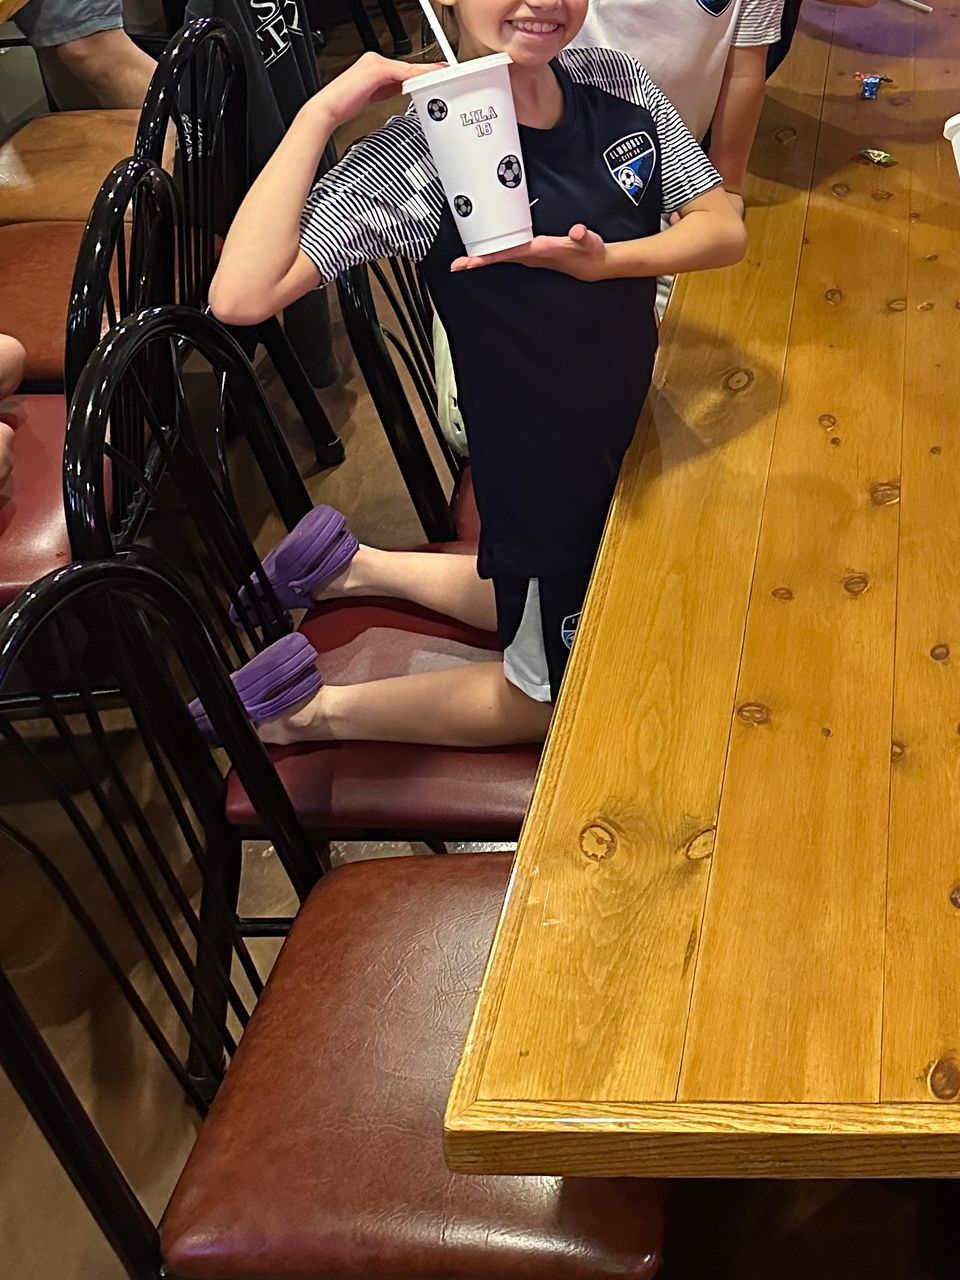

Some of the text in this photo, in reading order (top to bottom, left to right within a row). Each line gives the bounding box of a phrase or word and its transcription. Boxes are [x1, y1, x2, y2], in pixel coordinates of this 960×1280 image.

[460, 106, 498, 127] LILA
[475, 122, 492, 137] 18
[609, 136, 644, 160] ELMHURST
